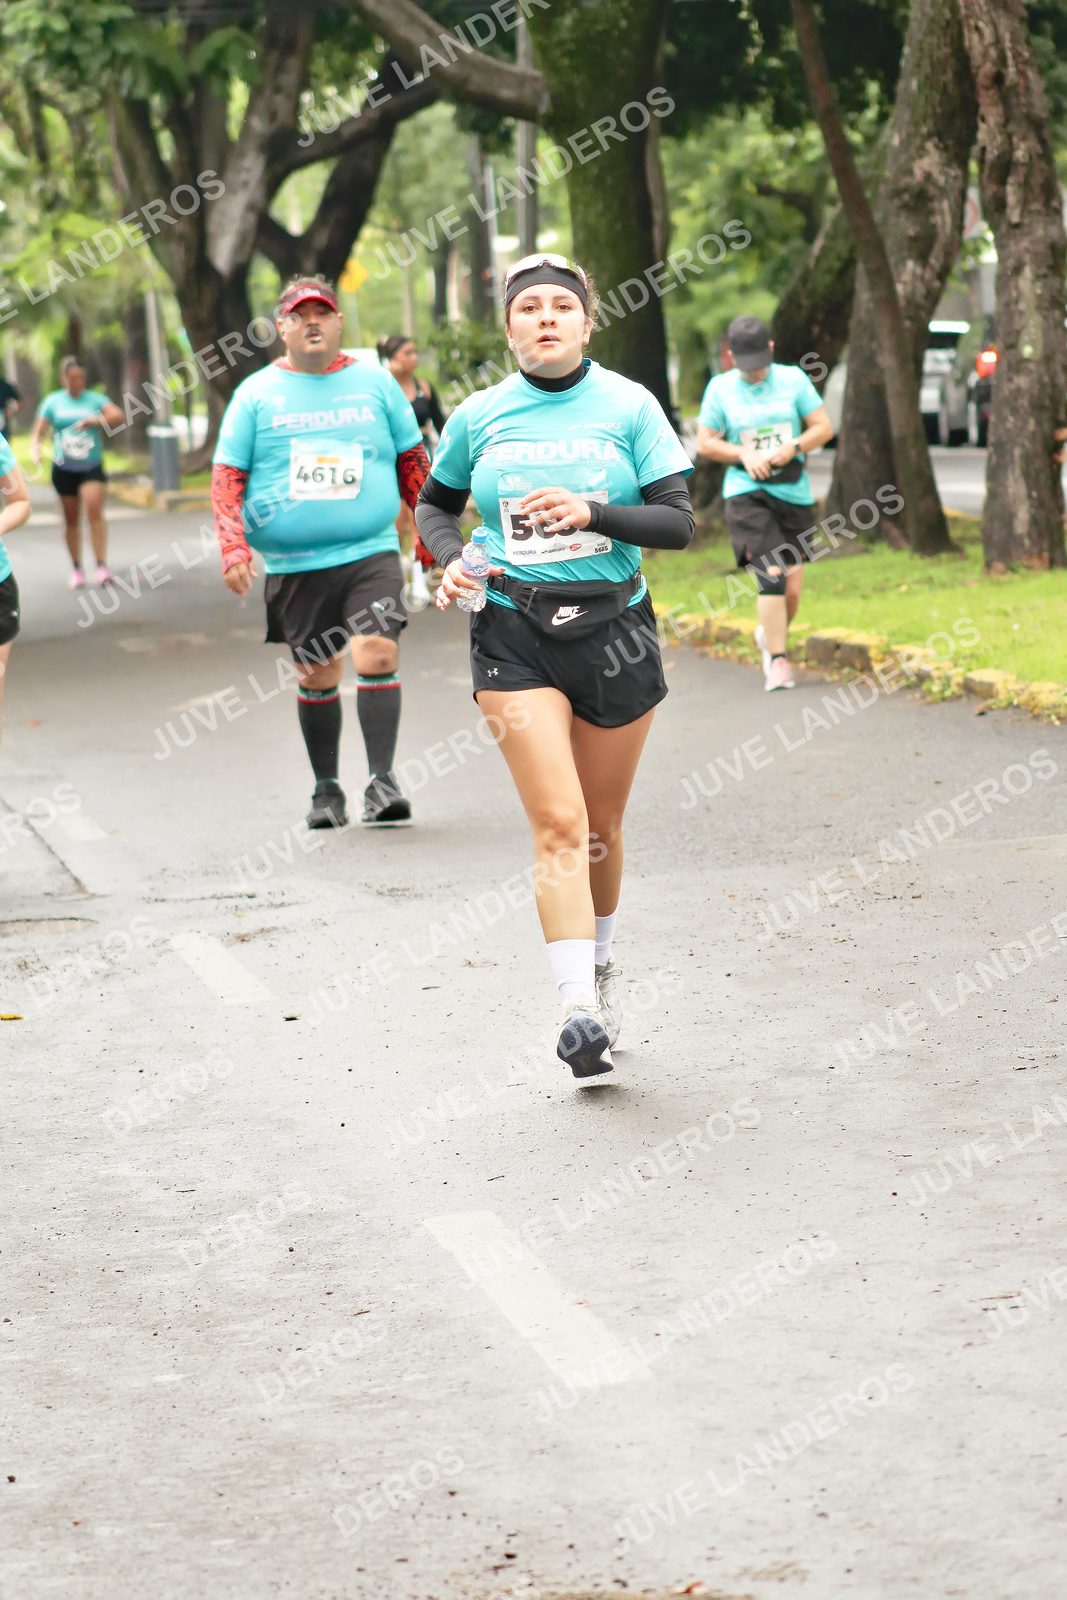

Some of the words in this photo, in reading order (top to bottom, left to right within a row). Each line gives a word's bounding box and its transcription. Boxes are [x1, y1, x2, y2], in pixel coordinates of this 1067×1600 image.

[272, 406, 376, 429] PERDURA
[752, 433, 782, 450] 273
[296, 466, 357, 485] 4616
[557, 605, 580, 617] NIKE
